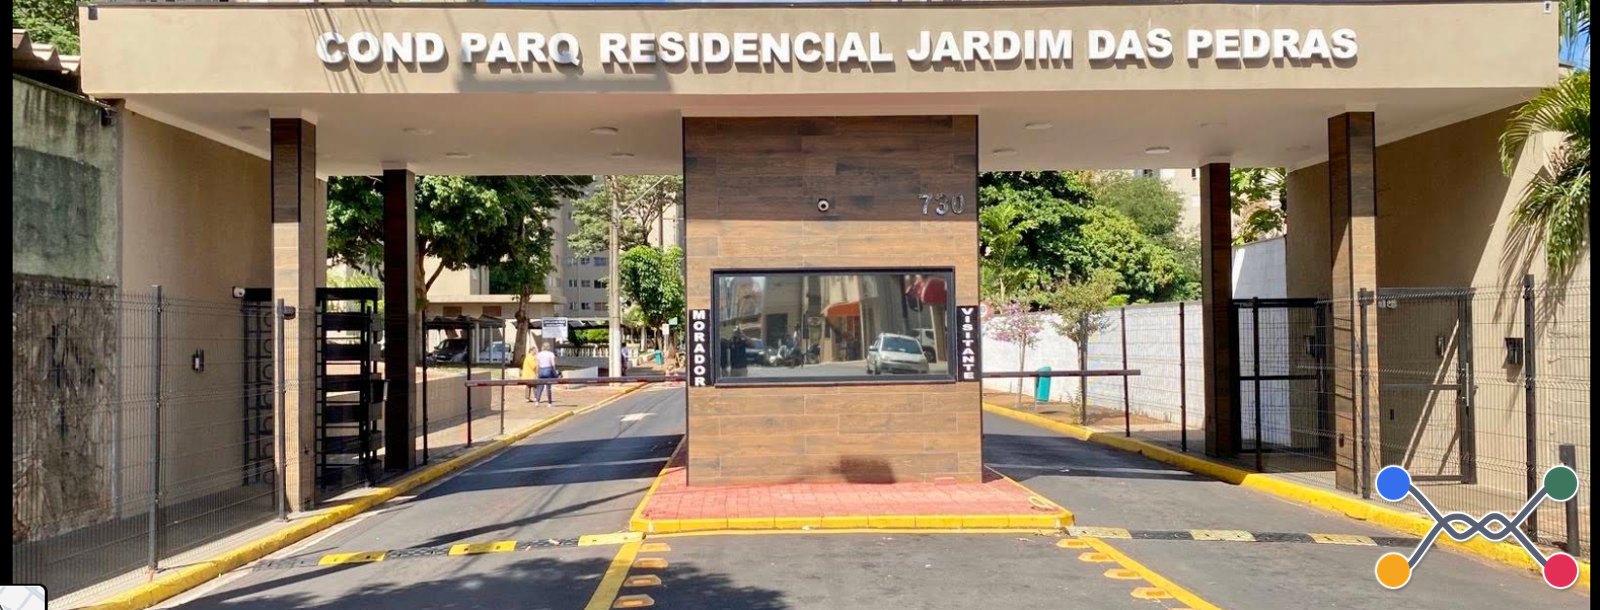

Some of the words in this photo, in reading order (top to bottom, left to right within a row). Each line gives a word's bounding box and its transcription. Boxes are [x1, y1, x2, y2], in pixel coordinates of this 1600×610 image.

[315, 31, 445, 64] COND
[461, 32, 581, 66] PARQ
[597, 31, 895, 65] RESIDENCIAL
[906, 28, 1073, 63] JARDIM
[1087, 28, 1174, 61] DAS
[1187, 27, 1359, 61] PEDRAS
[918, 193, 965, 216] 730
[692, 309, 706, 387] MORADOR
[960, 307, 975, 380] VISITANTE
